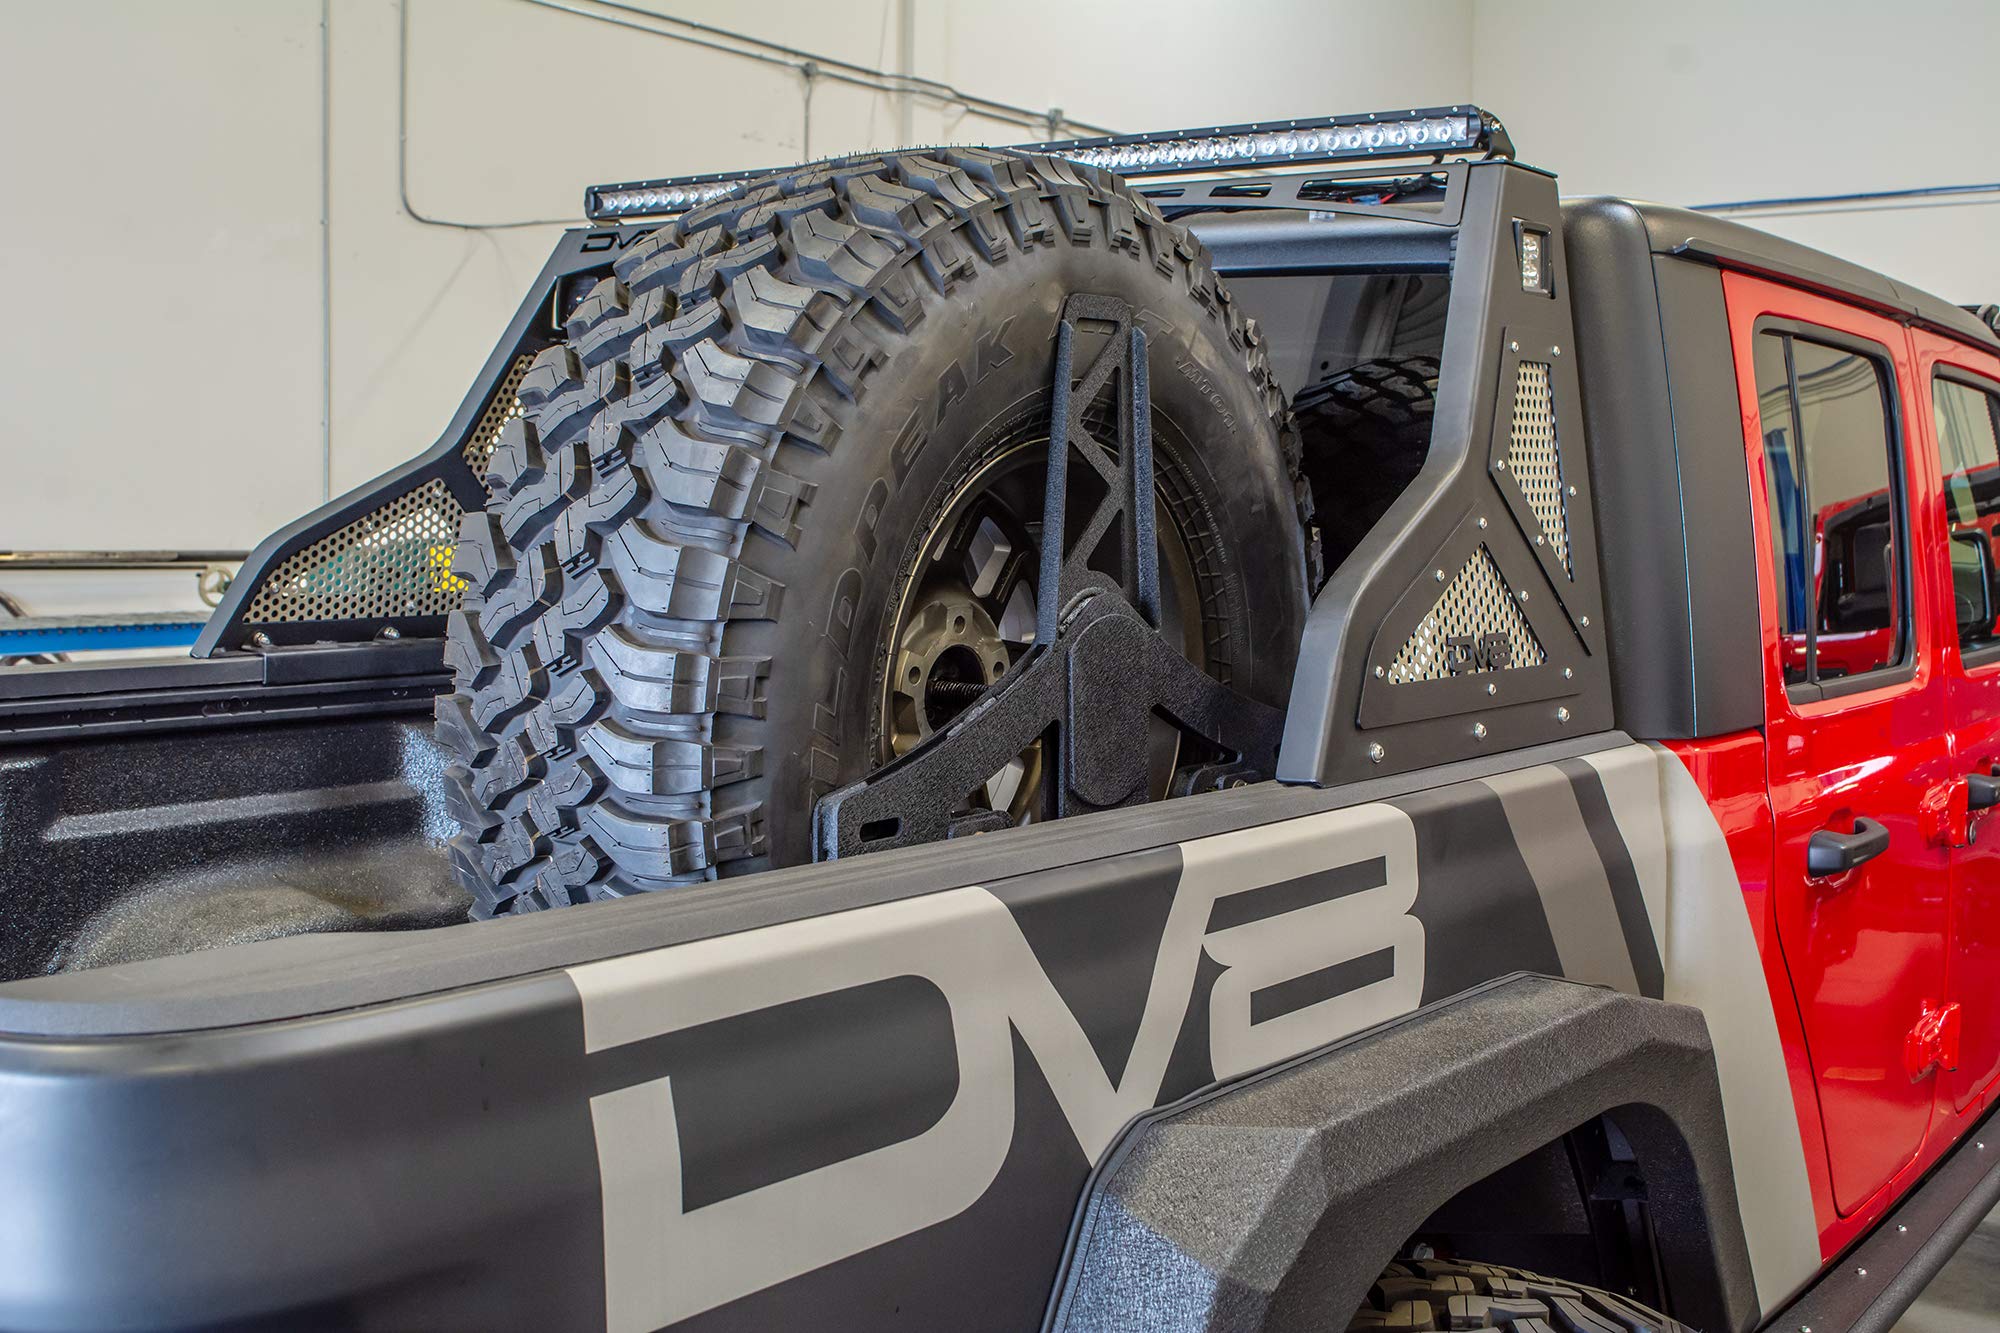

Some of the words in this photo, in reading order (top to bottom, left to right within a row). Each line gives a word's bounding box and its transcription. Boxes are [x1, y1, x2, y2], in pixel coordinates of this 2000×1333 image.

[580, 228, 658, 253] DV
[808, 314, 1017, 817] ILDPEAK
[1447, 631, 1512, 674] DV8
[565, 803, 1426, 1333] DV8
